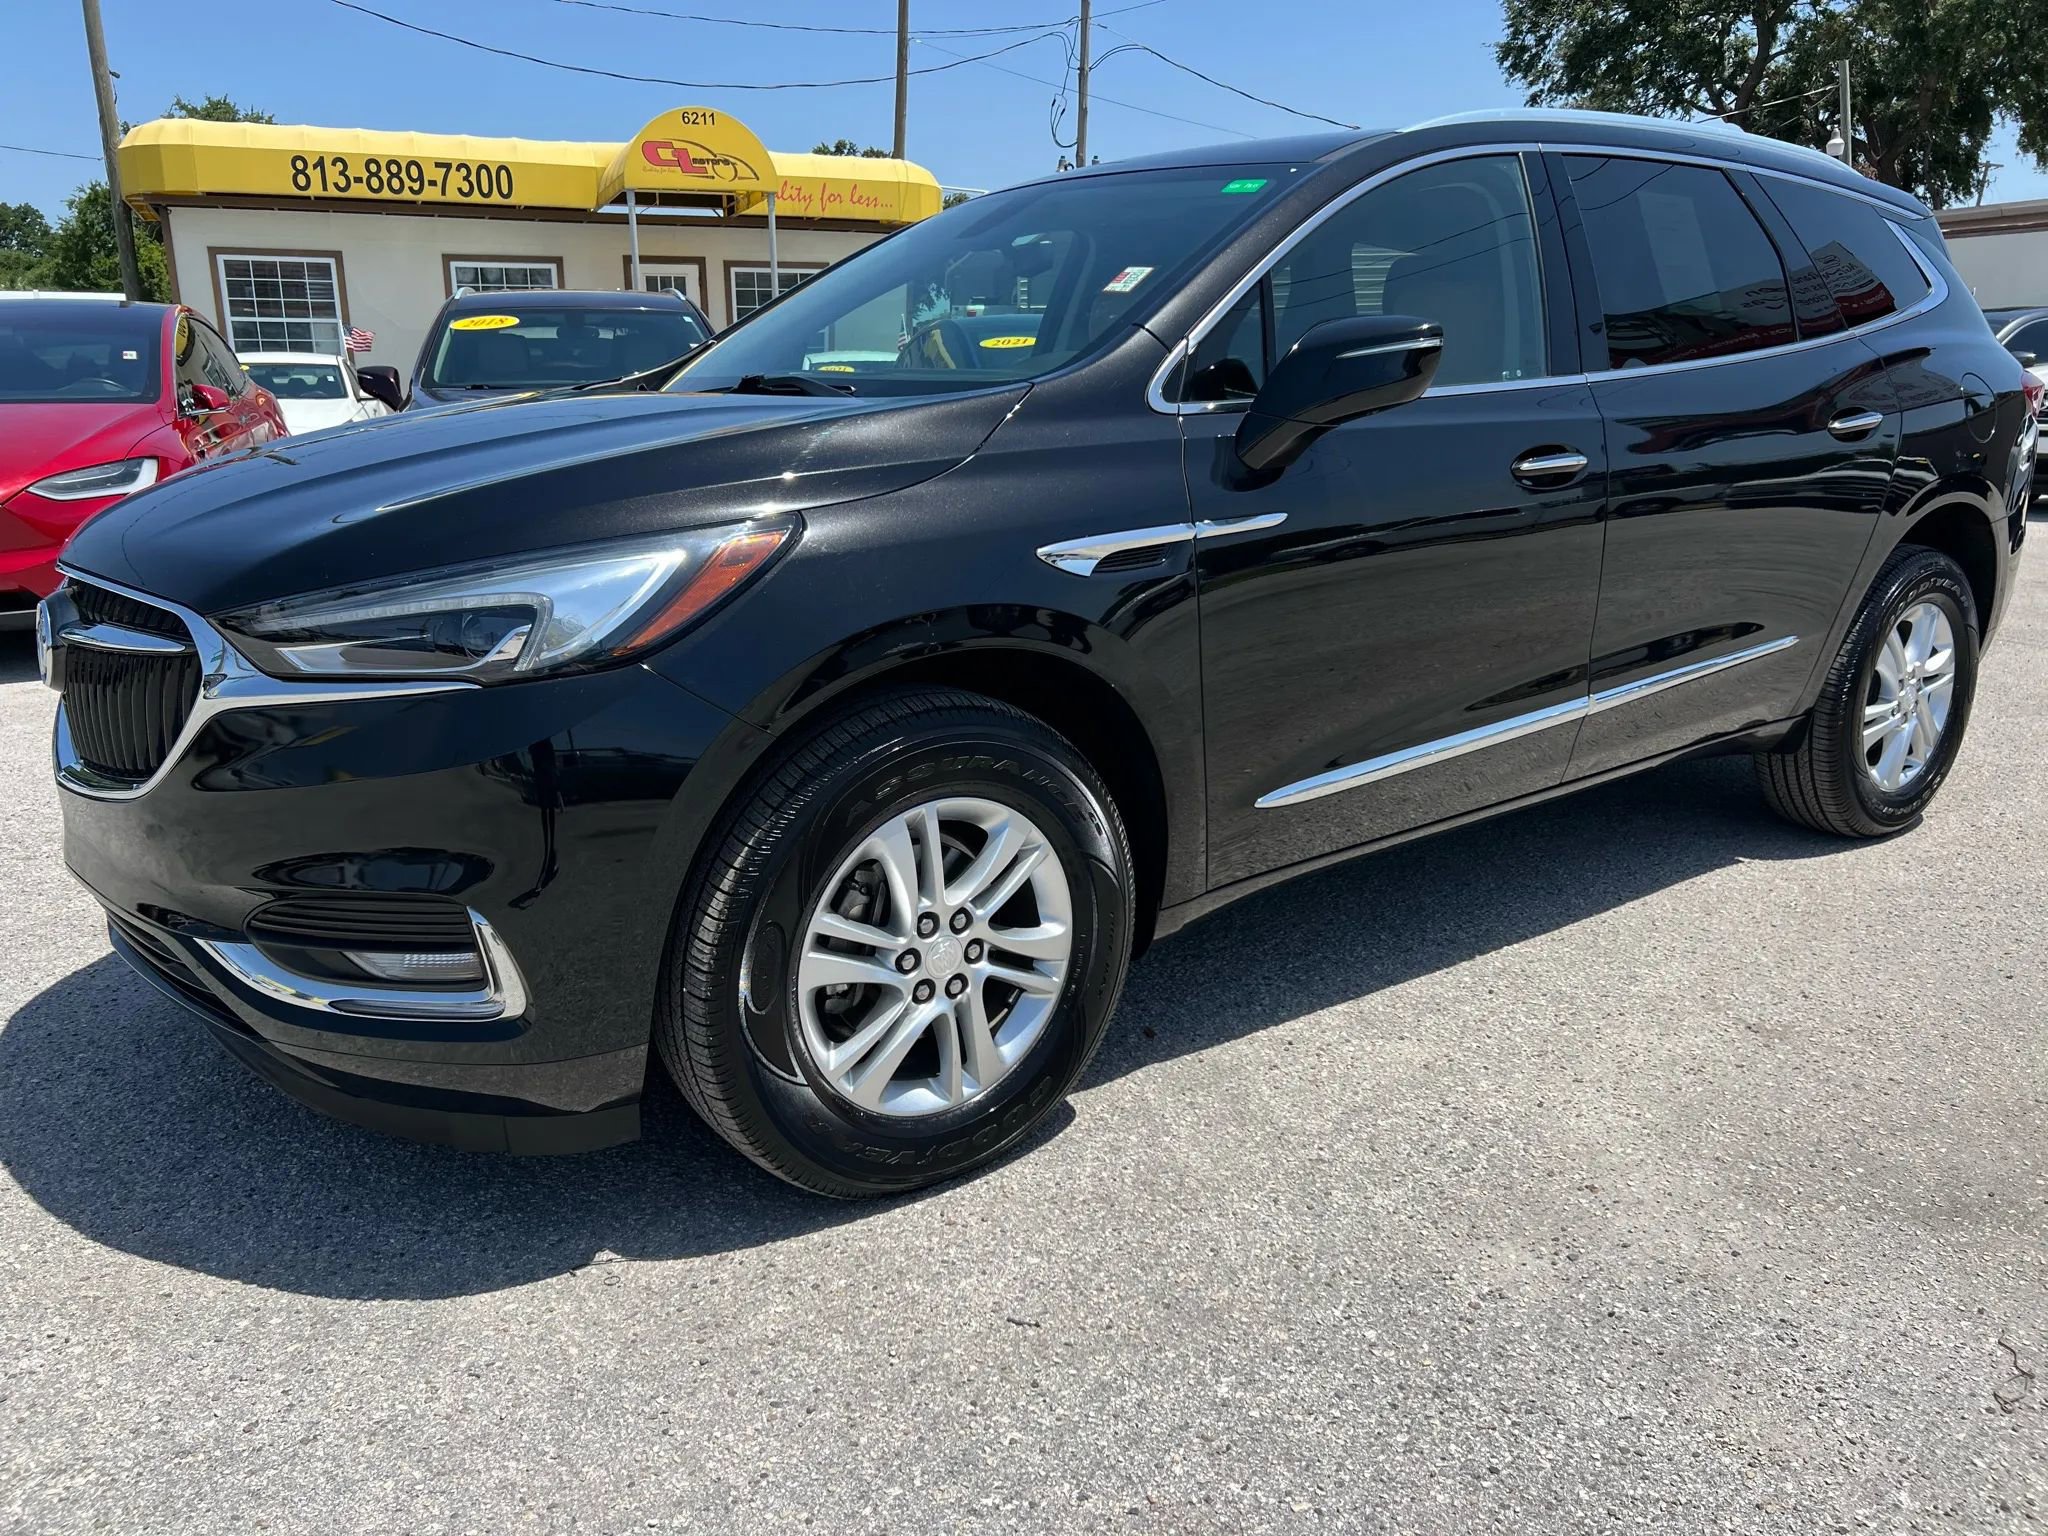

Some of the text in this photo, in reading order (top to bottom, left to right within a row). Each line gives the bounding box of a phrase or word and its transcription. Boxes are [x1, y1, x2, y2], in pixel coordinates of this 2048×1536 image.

[682, 111, 715, 126] 6211
[642, 140, 708, 174] CL
[290, 155, 514, 200] 813-889-7300
[820, 182, 842, 212] for
[463, 317, 508, 328] 2018
[991, 338, 1028, 347] 2021
